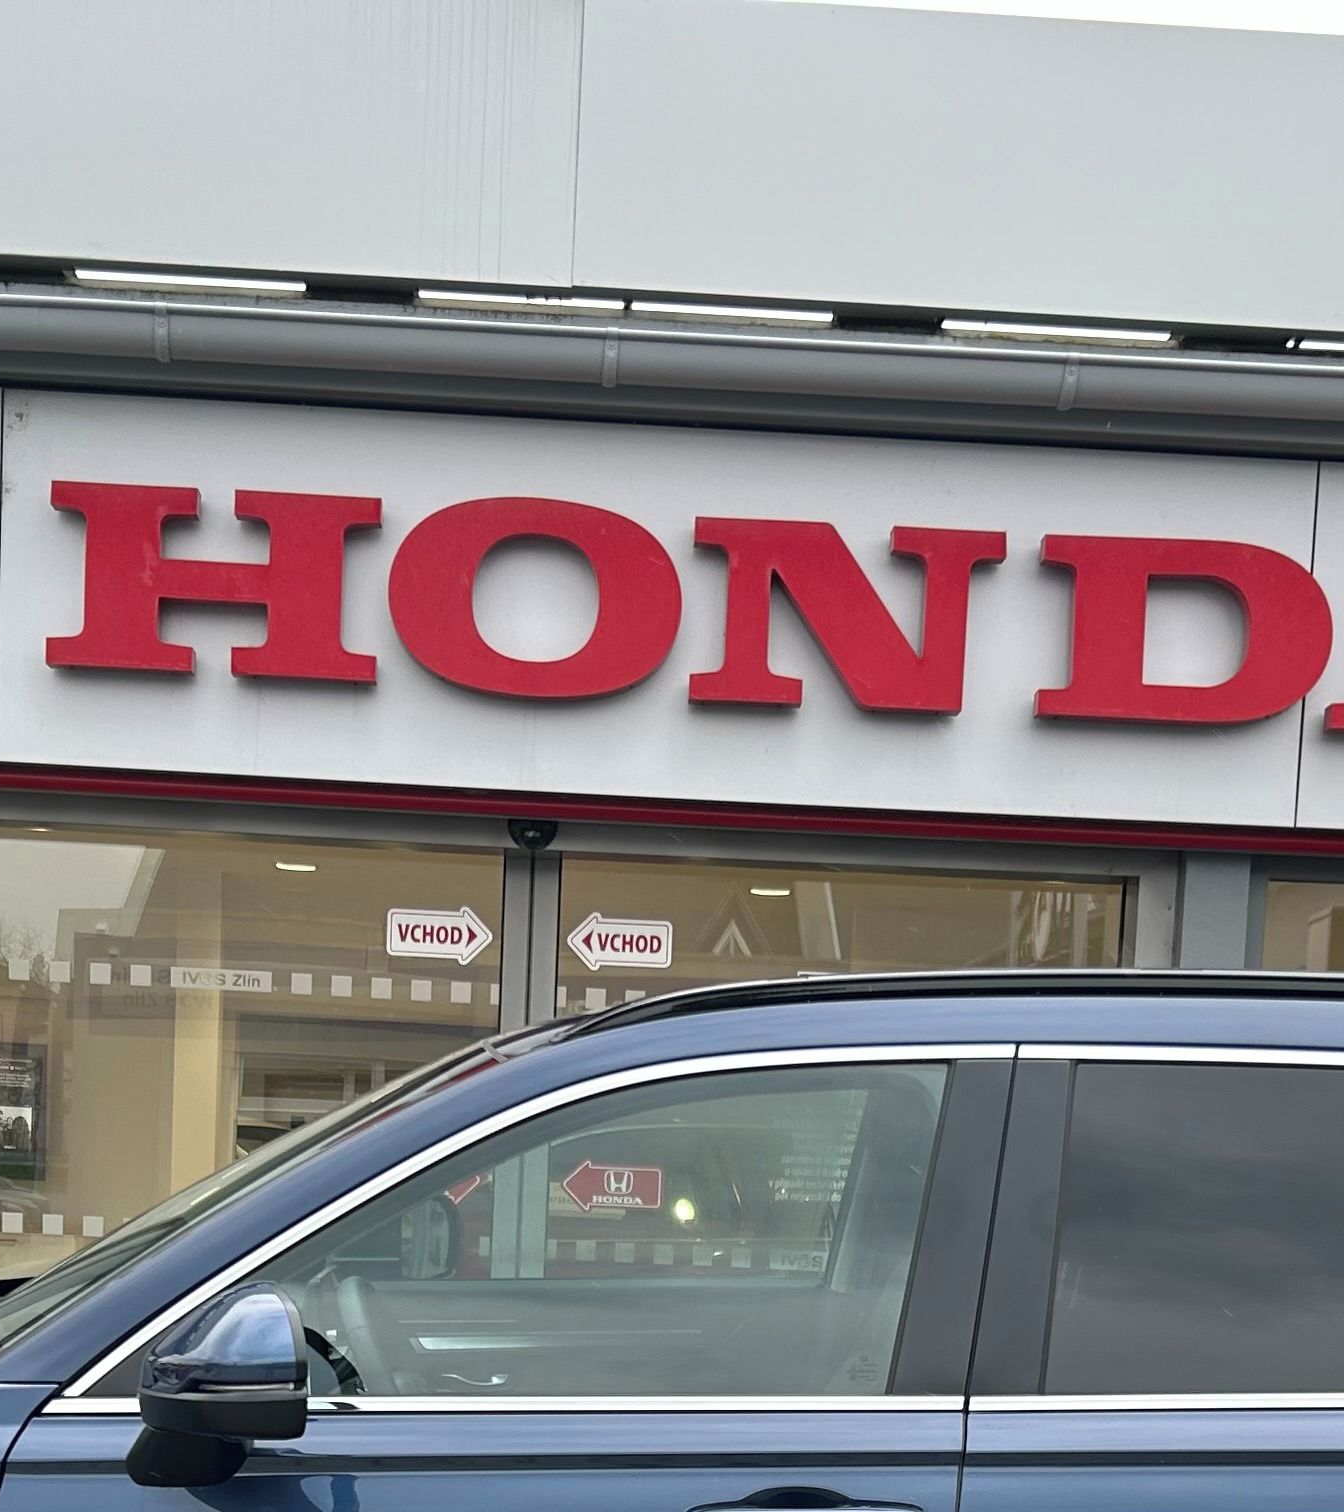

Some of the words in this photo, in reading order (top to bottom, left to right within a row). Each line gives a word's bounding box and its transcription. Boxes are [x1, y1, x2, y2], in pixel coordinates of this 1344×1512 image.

[397, 923, 463, 945] VCHOD
[597, 933, 662, 954] VCHOD
[232, 973, 261, 989] Zlín
[591, 1195, 644, 1206] HONDA
